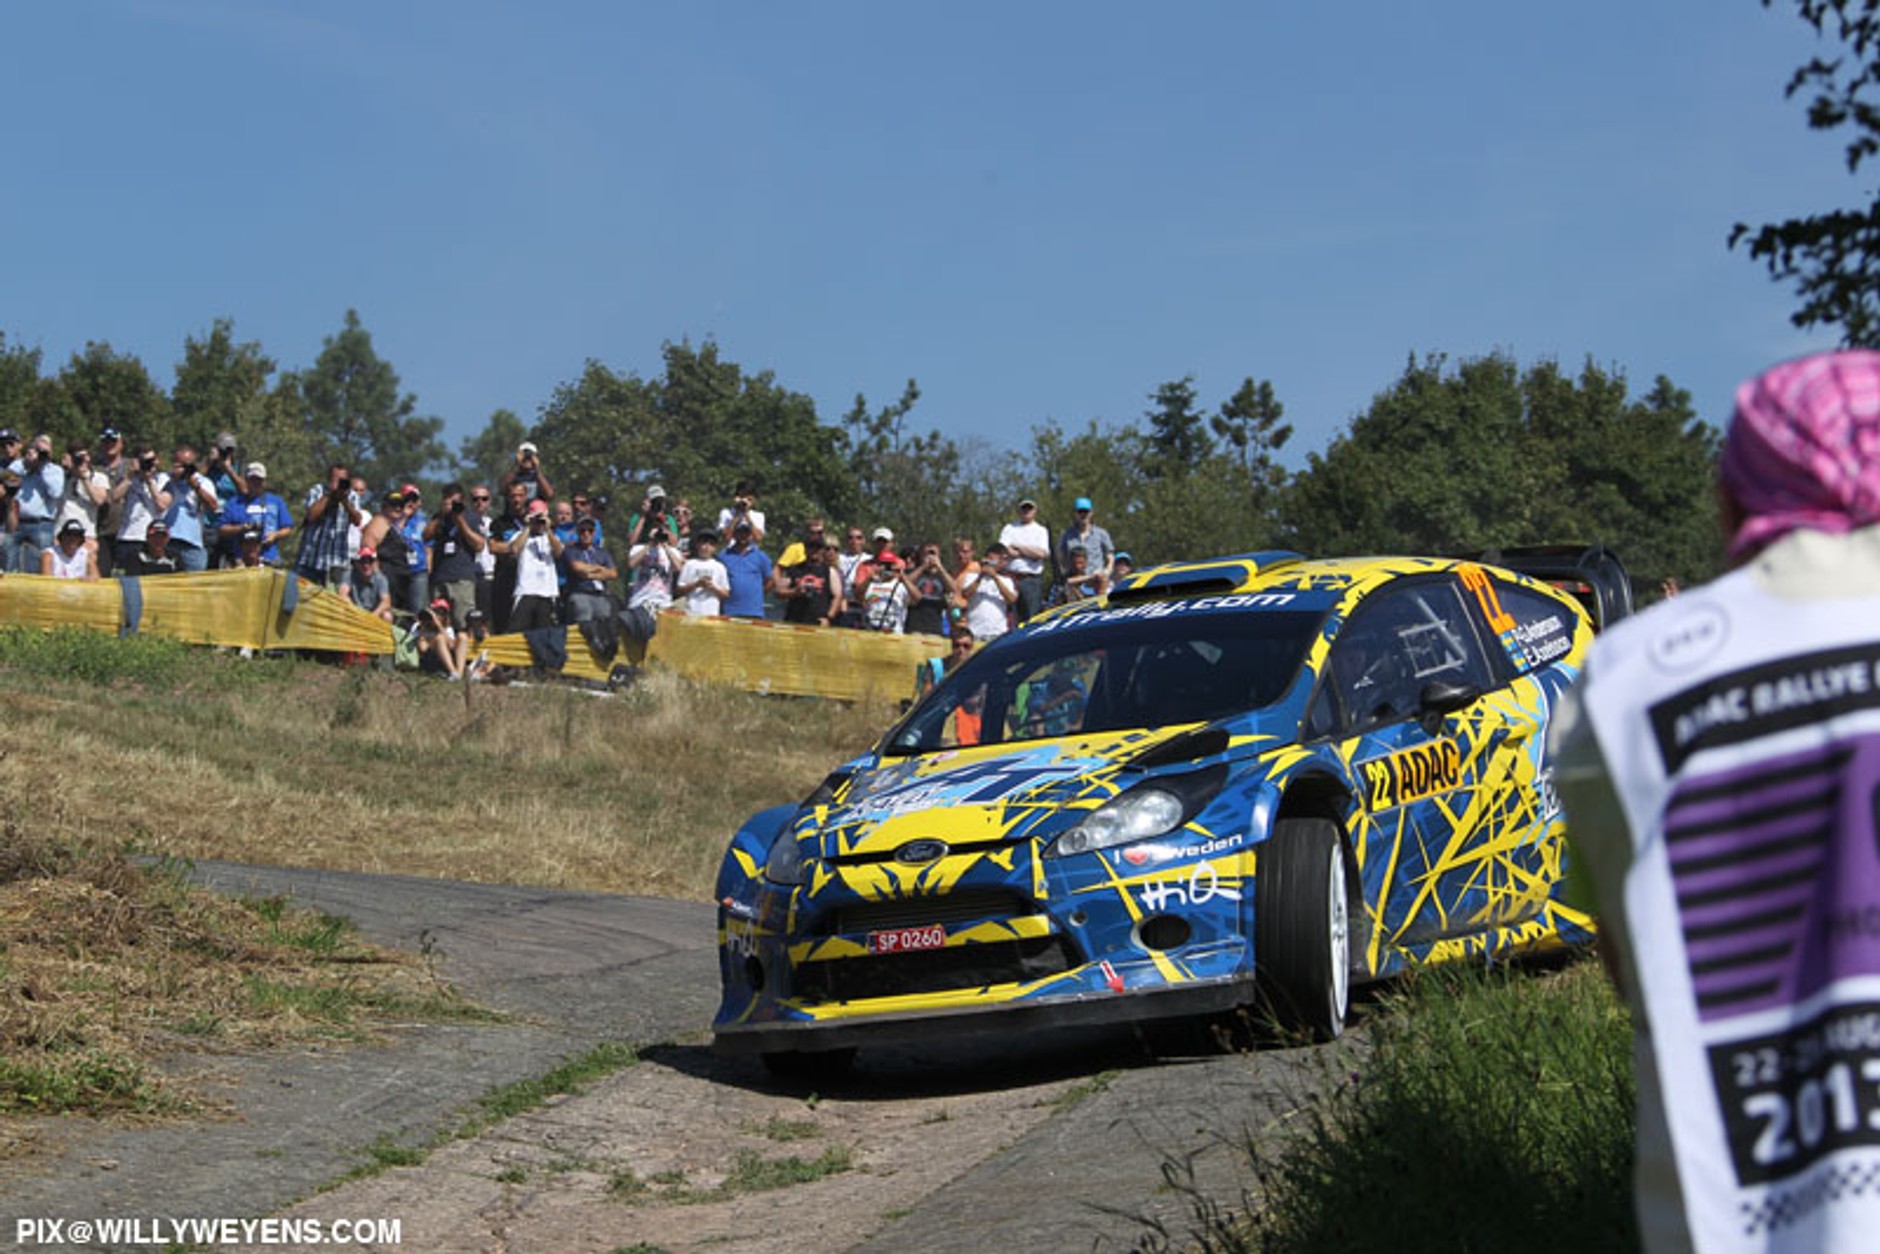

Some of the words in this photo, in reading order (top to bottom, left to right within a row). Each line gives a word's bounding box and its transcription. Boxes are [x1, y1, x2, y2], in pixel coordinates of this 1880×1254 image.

[1365, 760, 1392, 812] 22
[1398, 741, 1458, 801] ADAC
[879, 934, 898, 951] SP
[902, 929, 942, 949] 0260
